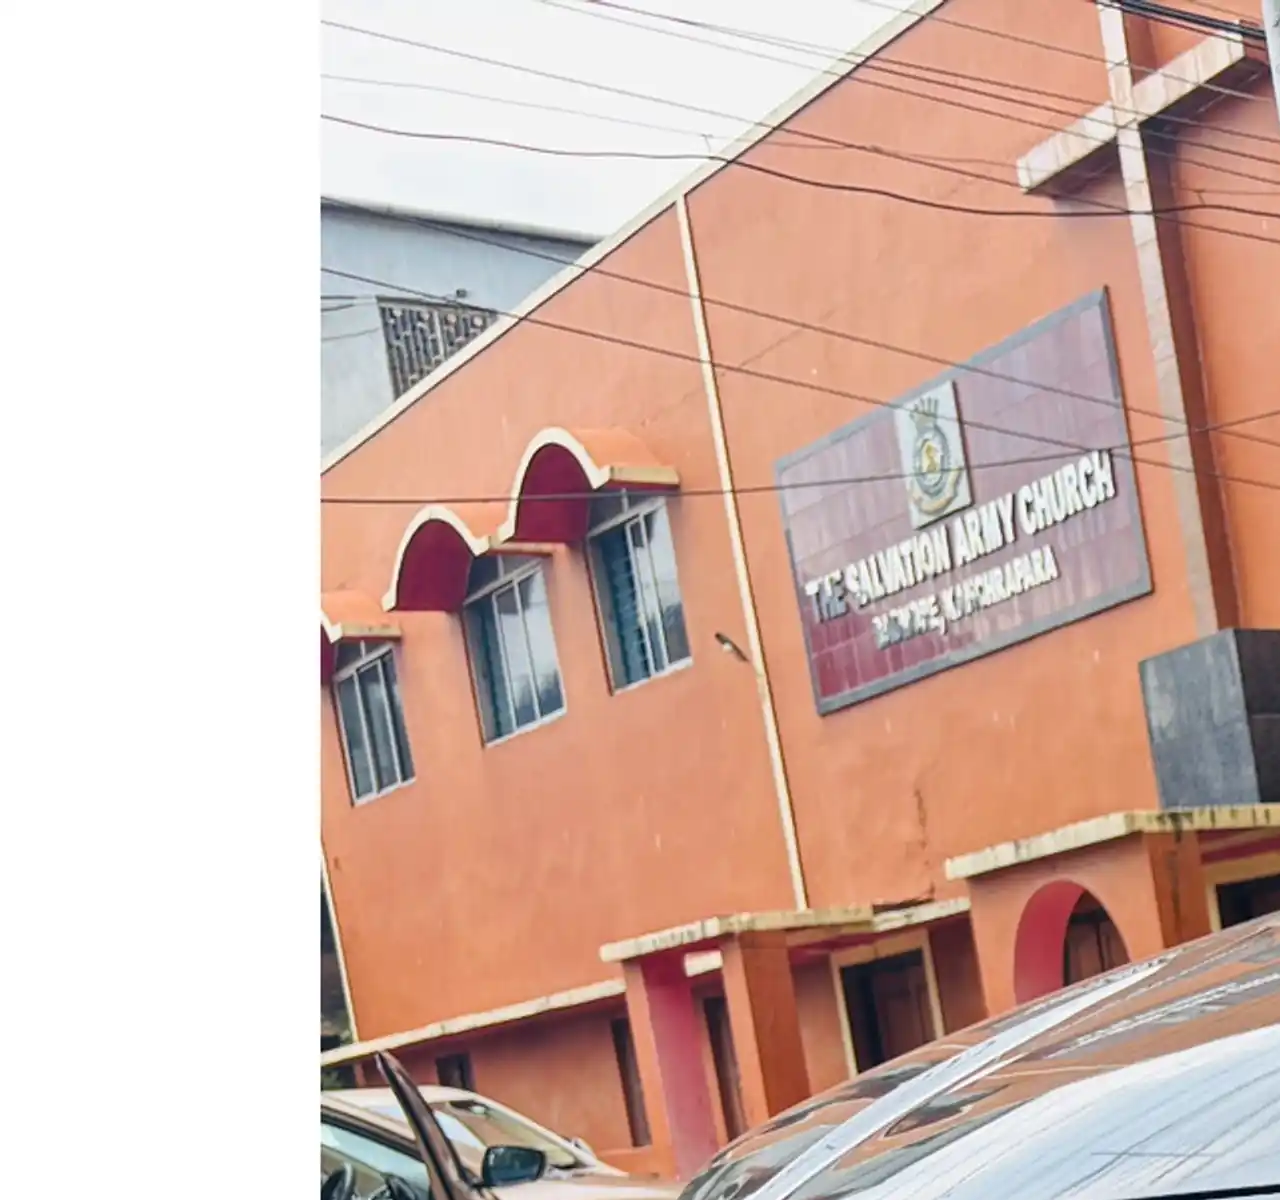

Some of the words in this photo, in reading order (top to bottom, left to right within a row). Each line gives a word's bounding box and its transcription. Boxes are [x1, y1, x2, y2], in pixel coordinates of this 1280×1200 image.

[804, 569, 848, 623] THE
[844, 526, 952, 608] SALVATION
[954, 492, 1017, 567] ARMY
[1016, 449, 1116, 536] CHURCH
